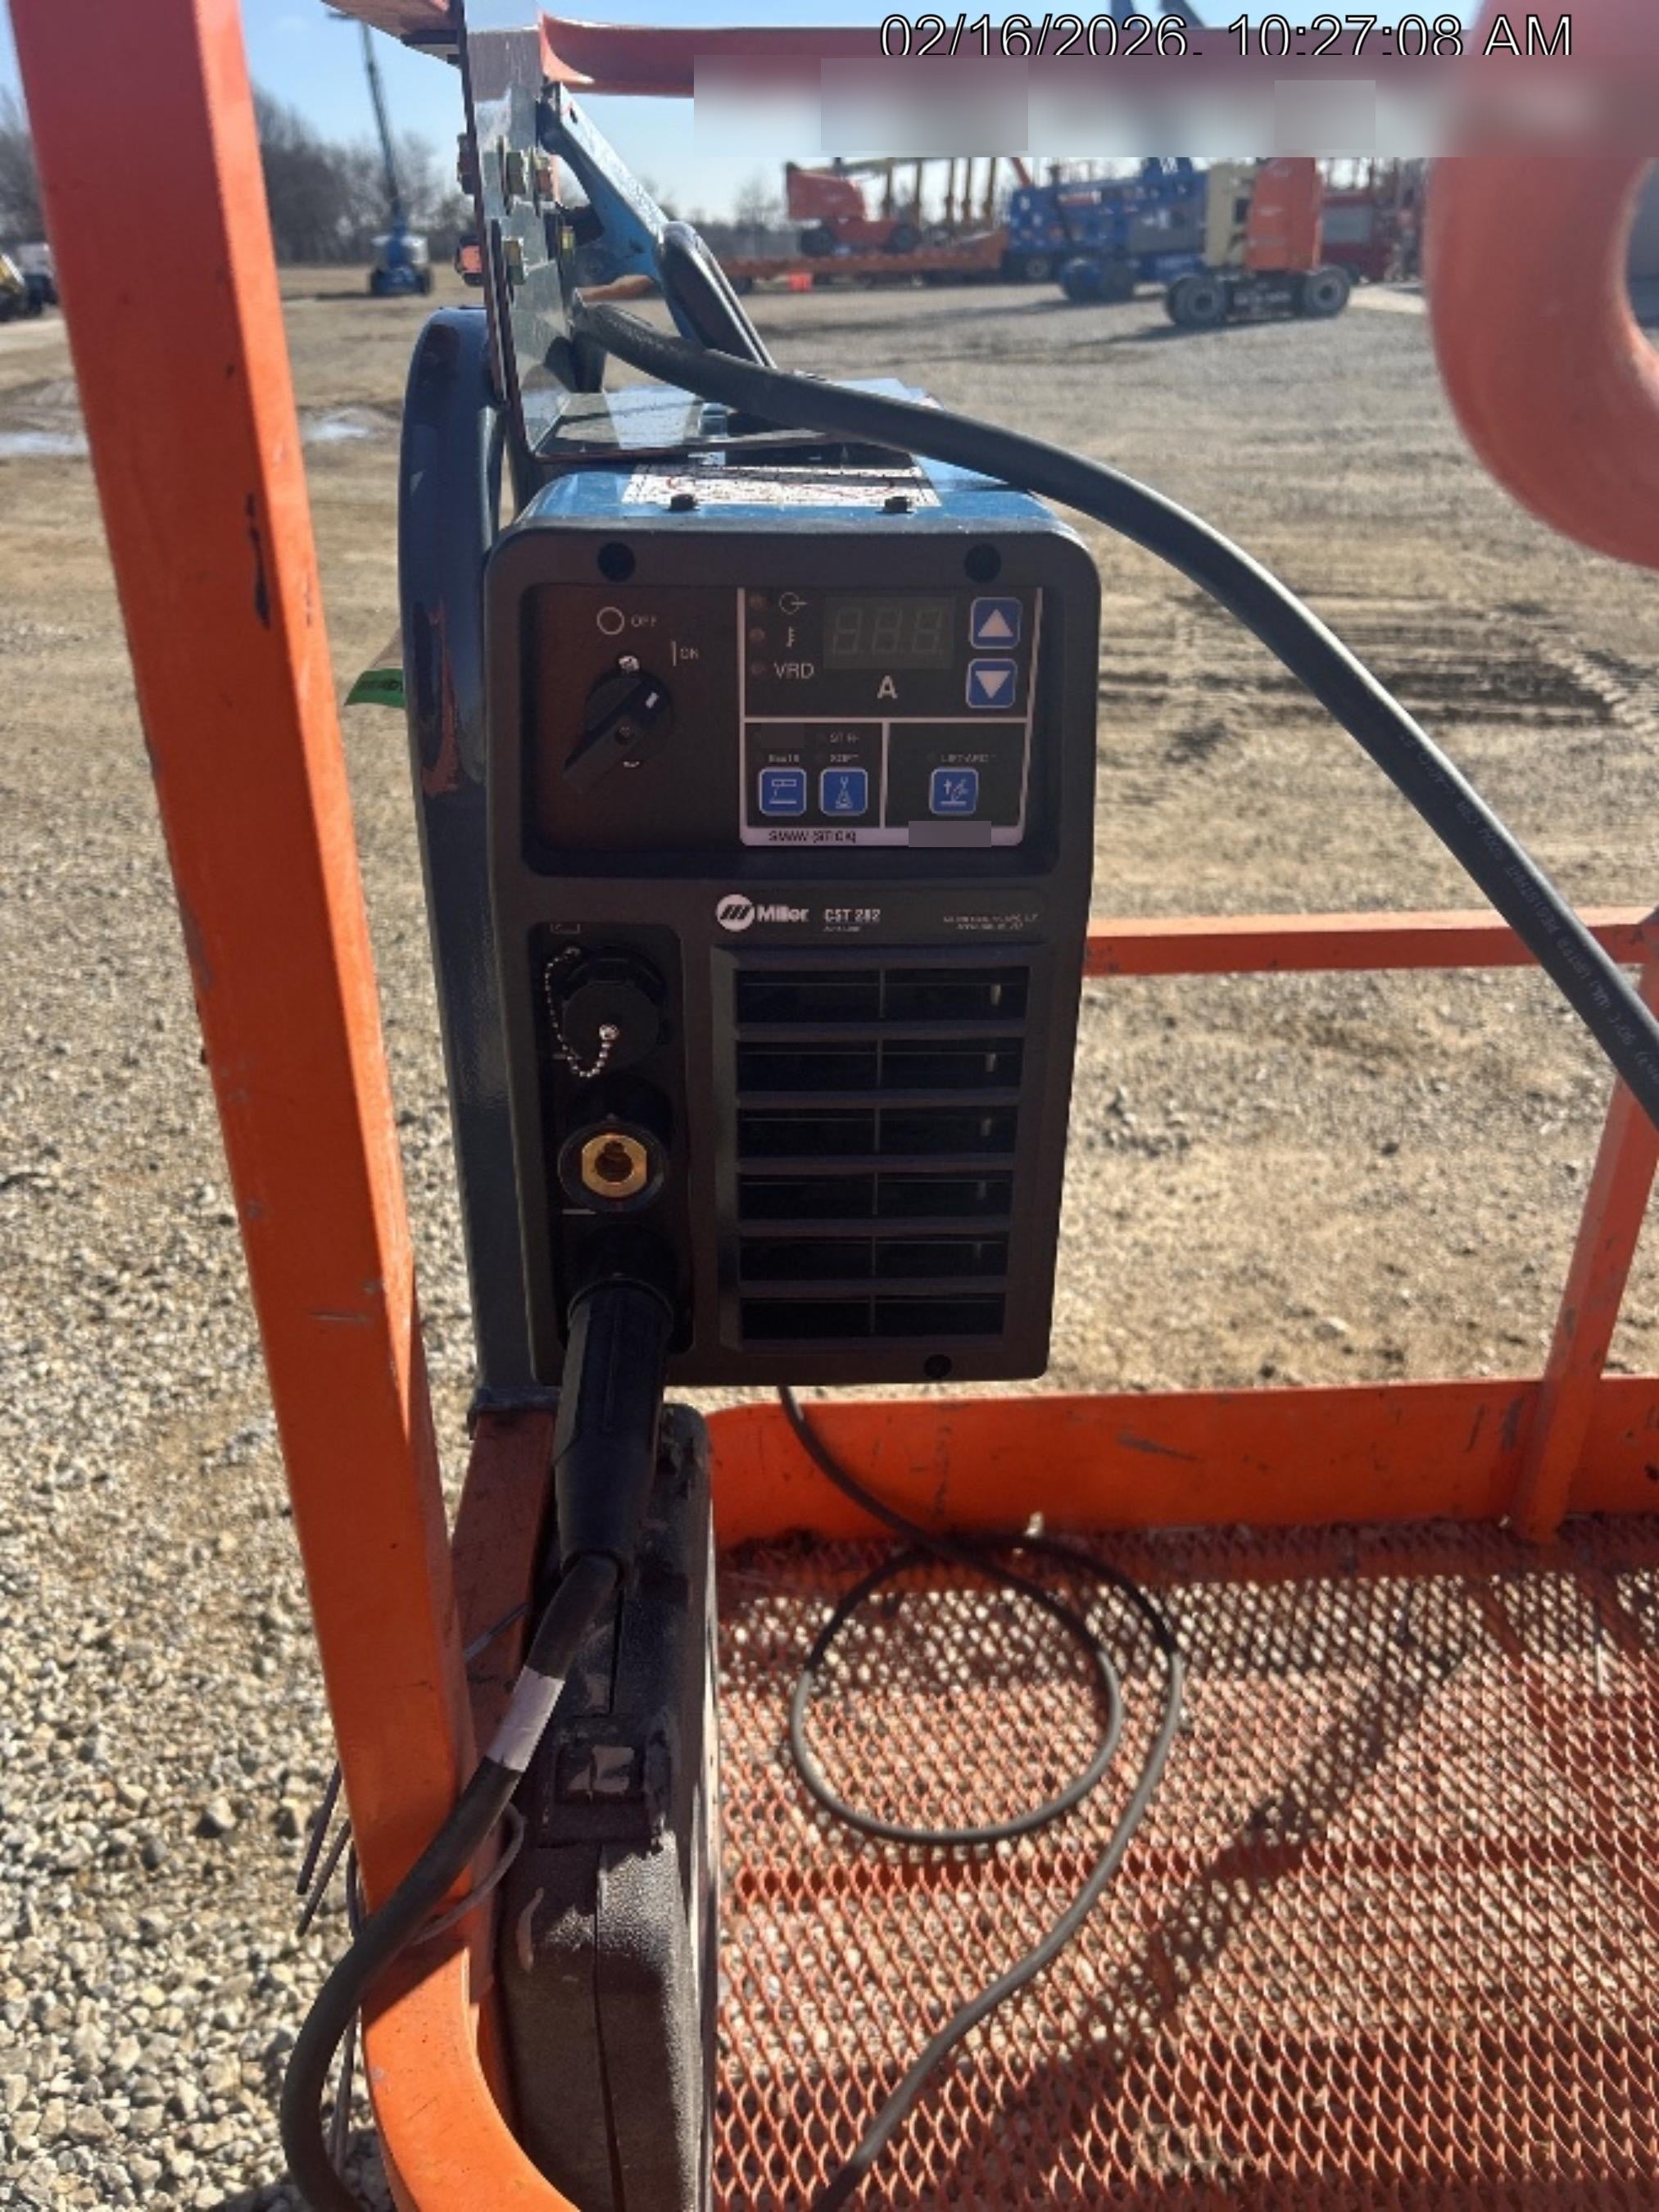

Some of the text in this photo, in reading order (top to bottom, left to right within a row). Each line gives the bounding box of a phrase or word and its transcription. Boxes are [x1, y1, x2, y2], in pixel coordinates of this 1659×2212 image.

[773, 662, 814, 679] VRD
[877, 675, 898, 699] A
[757, 904, 809, 922] Miller
[825, 909, 853, 922] CST
